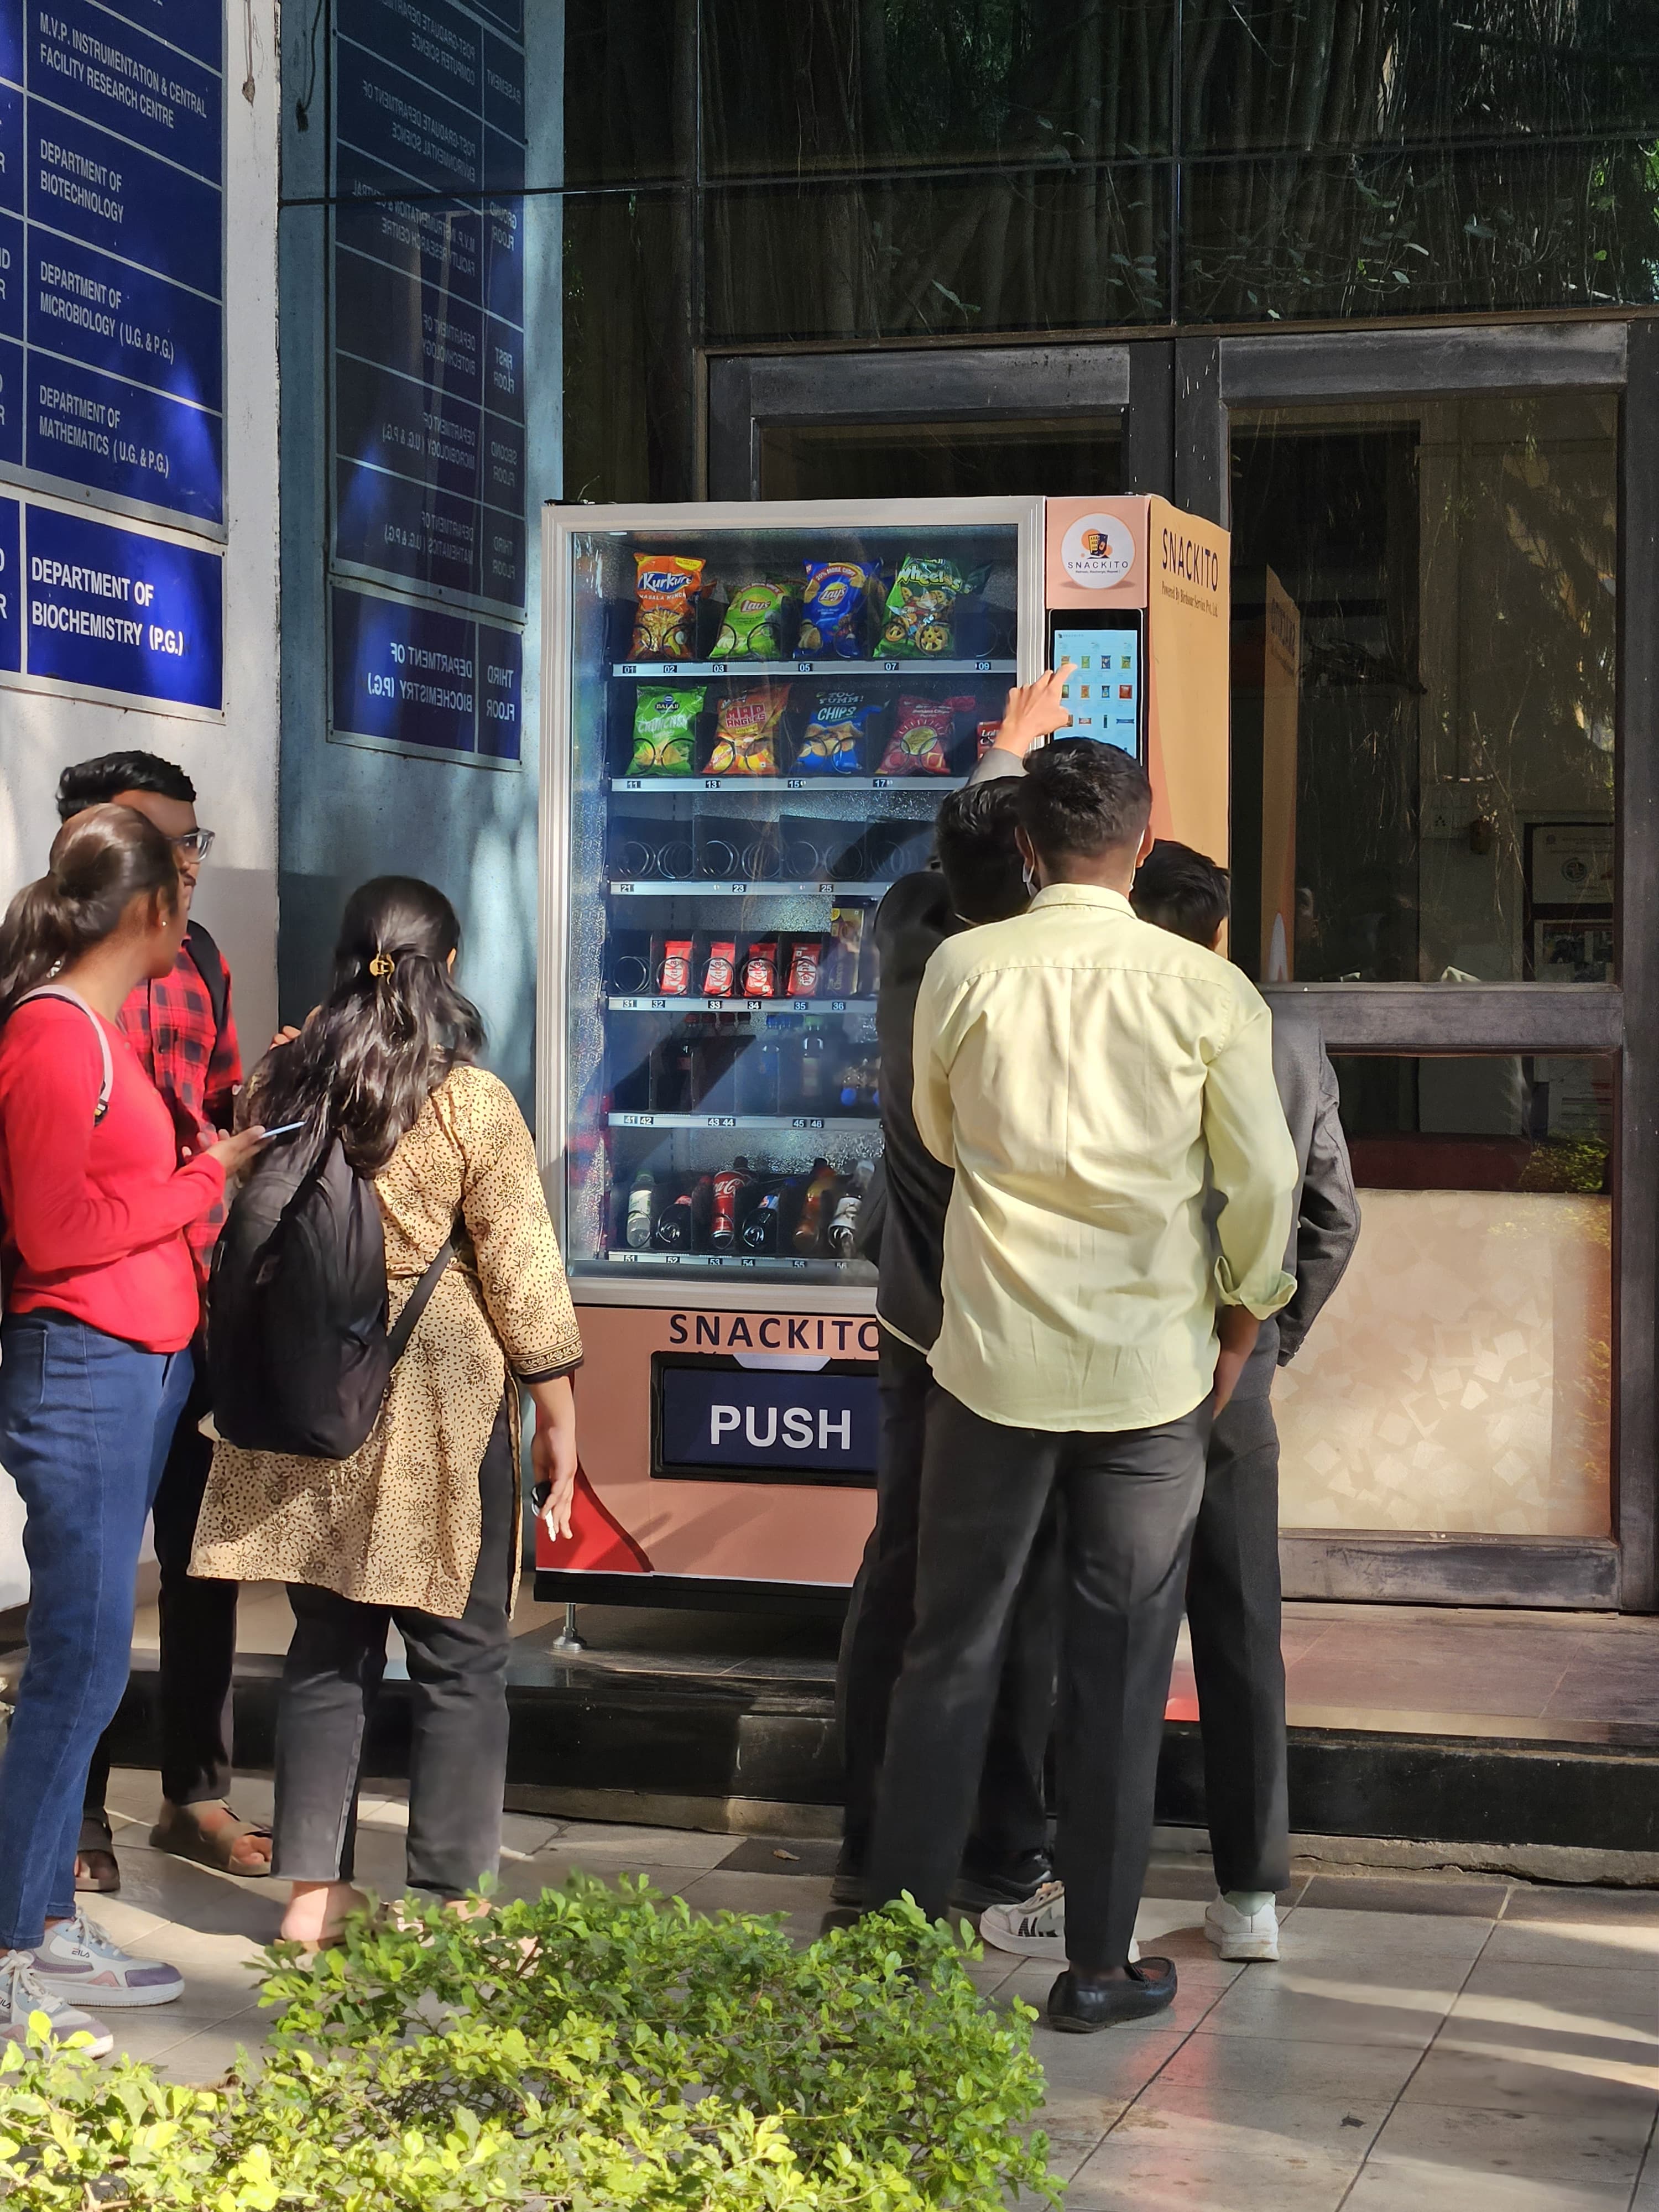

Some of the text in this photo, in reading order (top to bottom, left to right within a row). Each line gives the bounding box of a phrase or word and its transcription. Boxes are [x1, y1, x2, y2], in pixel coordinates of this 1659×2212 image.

[40, 12, 207, 119] M.V.P. INSTRUMENTATION & CENTRAL
[40, 43, 174, 129] FACILITY RESEARCH CENTRE
[40, 138, 107, 186] DEPARTMENT
[109, 171, 122, 193] OF
[40, 170, 124, 223] BIOTECHNOLOGY
[40, 261, 107, 304] DEPARTMENT
[109, 288, 122, 309] OF
[40, 292, 116, 338] MICROBIOLOGY
[145, 333, 152, 352] &
[154, 336, 175, 365] P.G.)
[40, 385, 105, 425] DEPARTMENT
[107, 408, 121, 429] OF
[39, 415, 109, 456] MATHEMATICS
[140, 452, 147, 467] &
[148, 453, 169, 478] P.G.)
[32, 557, 131, 601] DEPARTMENT
[134, 581, 154, 607] OF
[643, 573, 692, 593] Kurkure
[1068, 561, 1128, 569] SNACKITO
[1162, 528, 1218, 592] SNACKITO
[32, 601, 143, 646] BIOCHEMISTRY
[149, 624, 184, 656] (P.G.)
[726, 704, 765, 718] MAD
[726, 713, 766, 727] ANGLES
[817, 707, 857, 721] CHIPS
[653, 1000, 663, 1008] 32
[711, 1405, 851, 1450] PUSH
[71, 1948, 90, 1958] FILA
